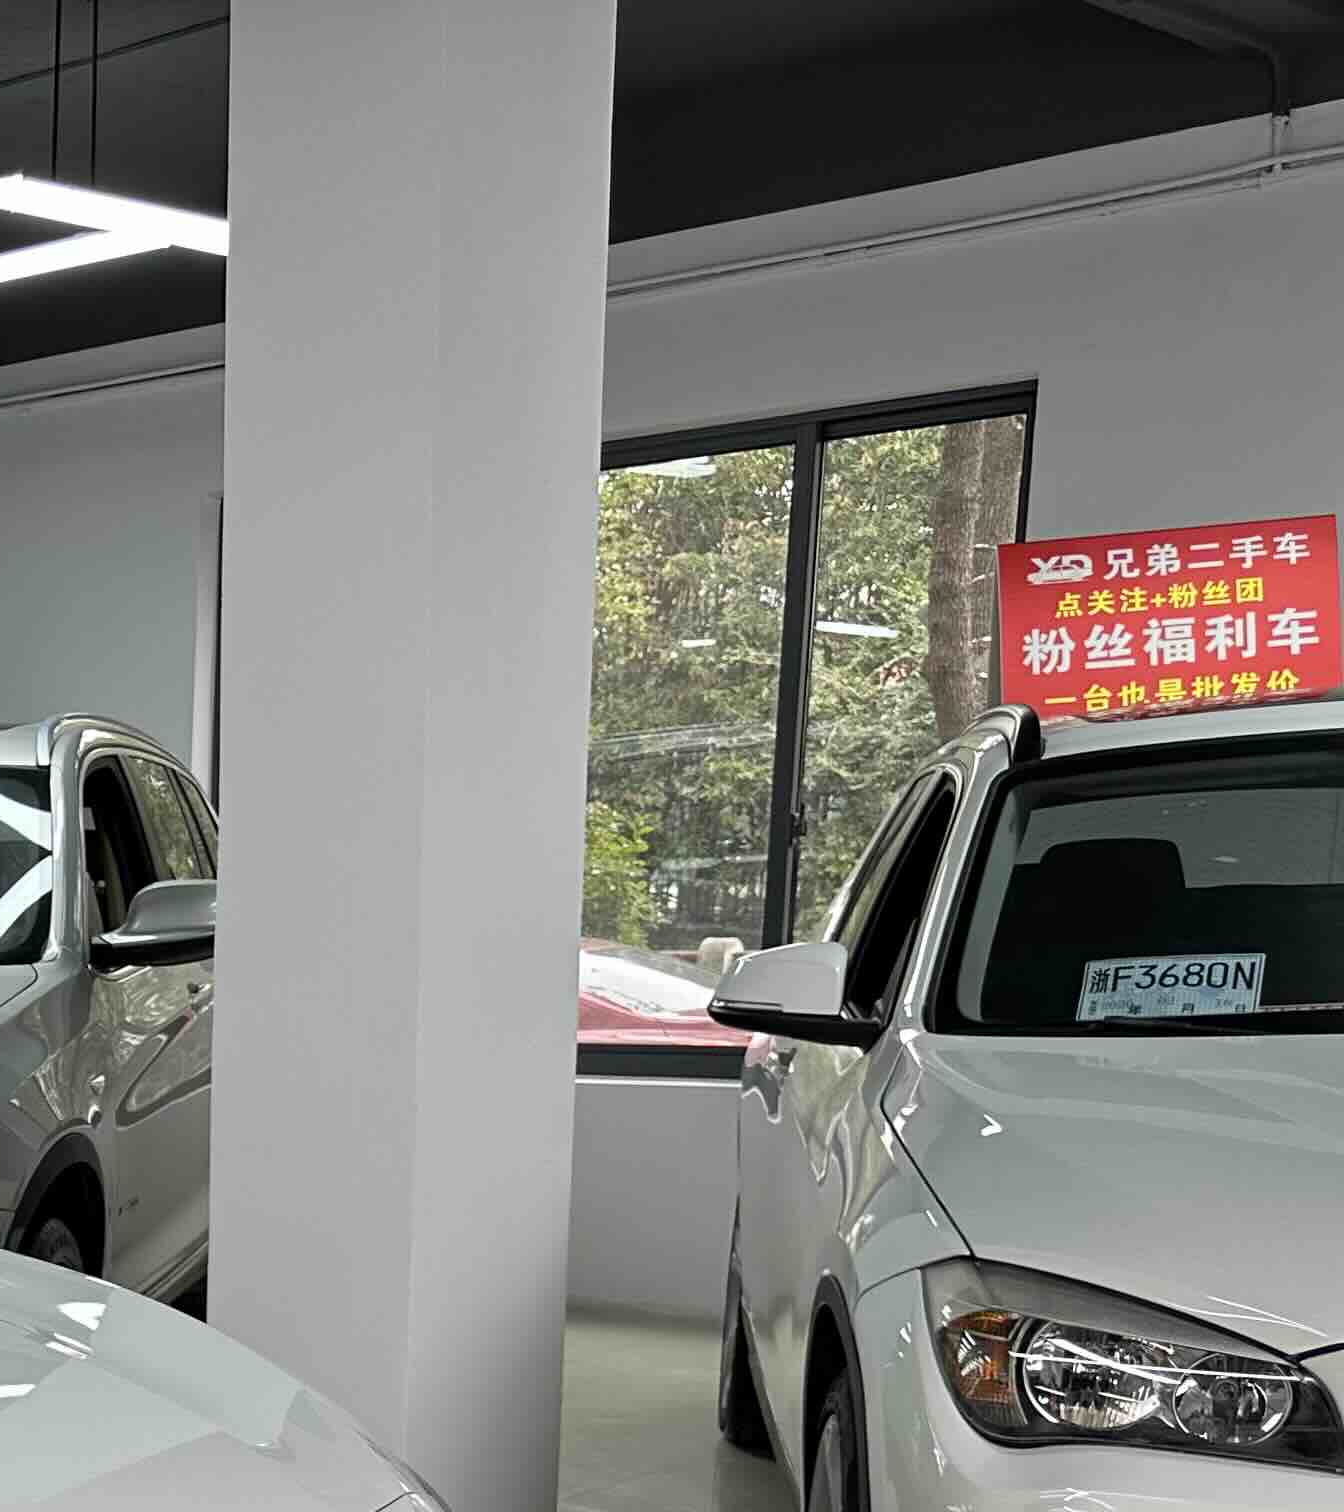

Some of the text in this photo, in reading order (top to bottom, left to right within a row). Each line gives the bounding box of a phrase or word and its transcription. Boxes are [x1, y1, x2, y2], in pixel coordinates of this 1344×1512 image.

[1103, 532, 1311, 580] 兄弟二手车
[1055, 577, 1264, 618] 点关注+粉丝团
[1022, 607, 1320, 675] 粉丝福利车
[1045, 668, 1300, 712] 一台也是批发价
